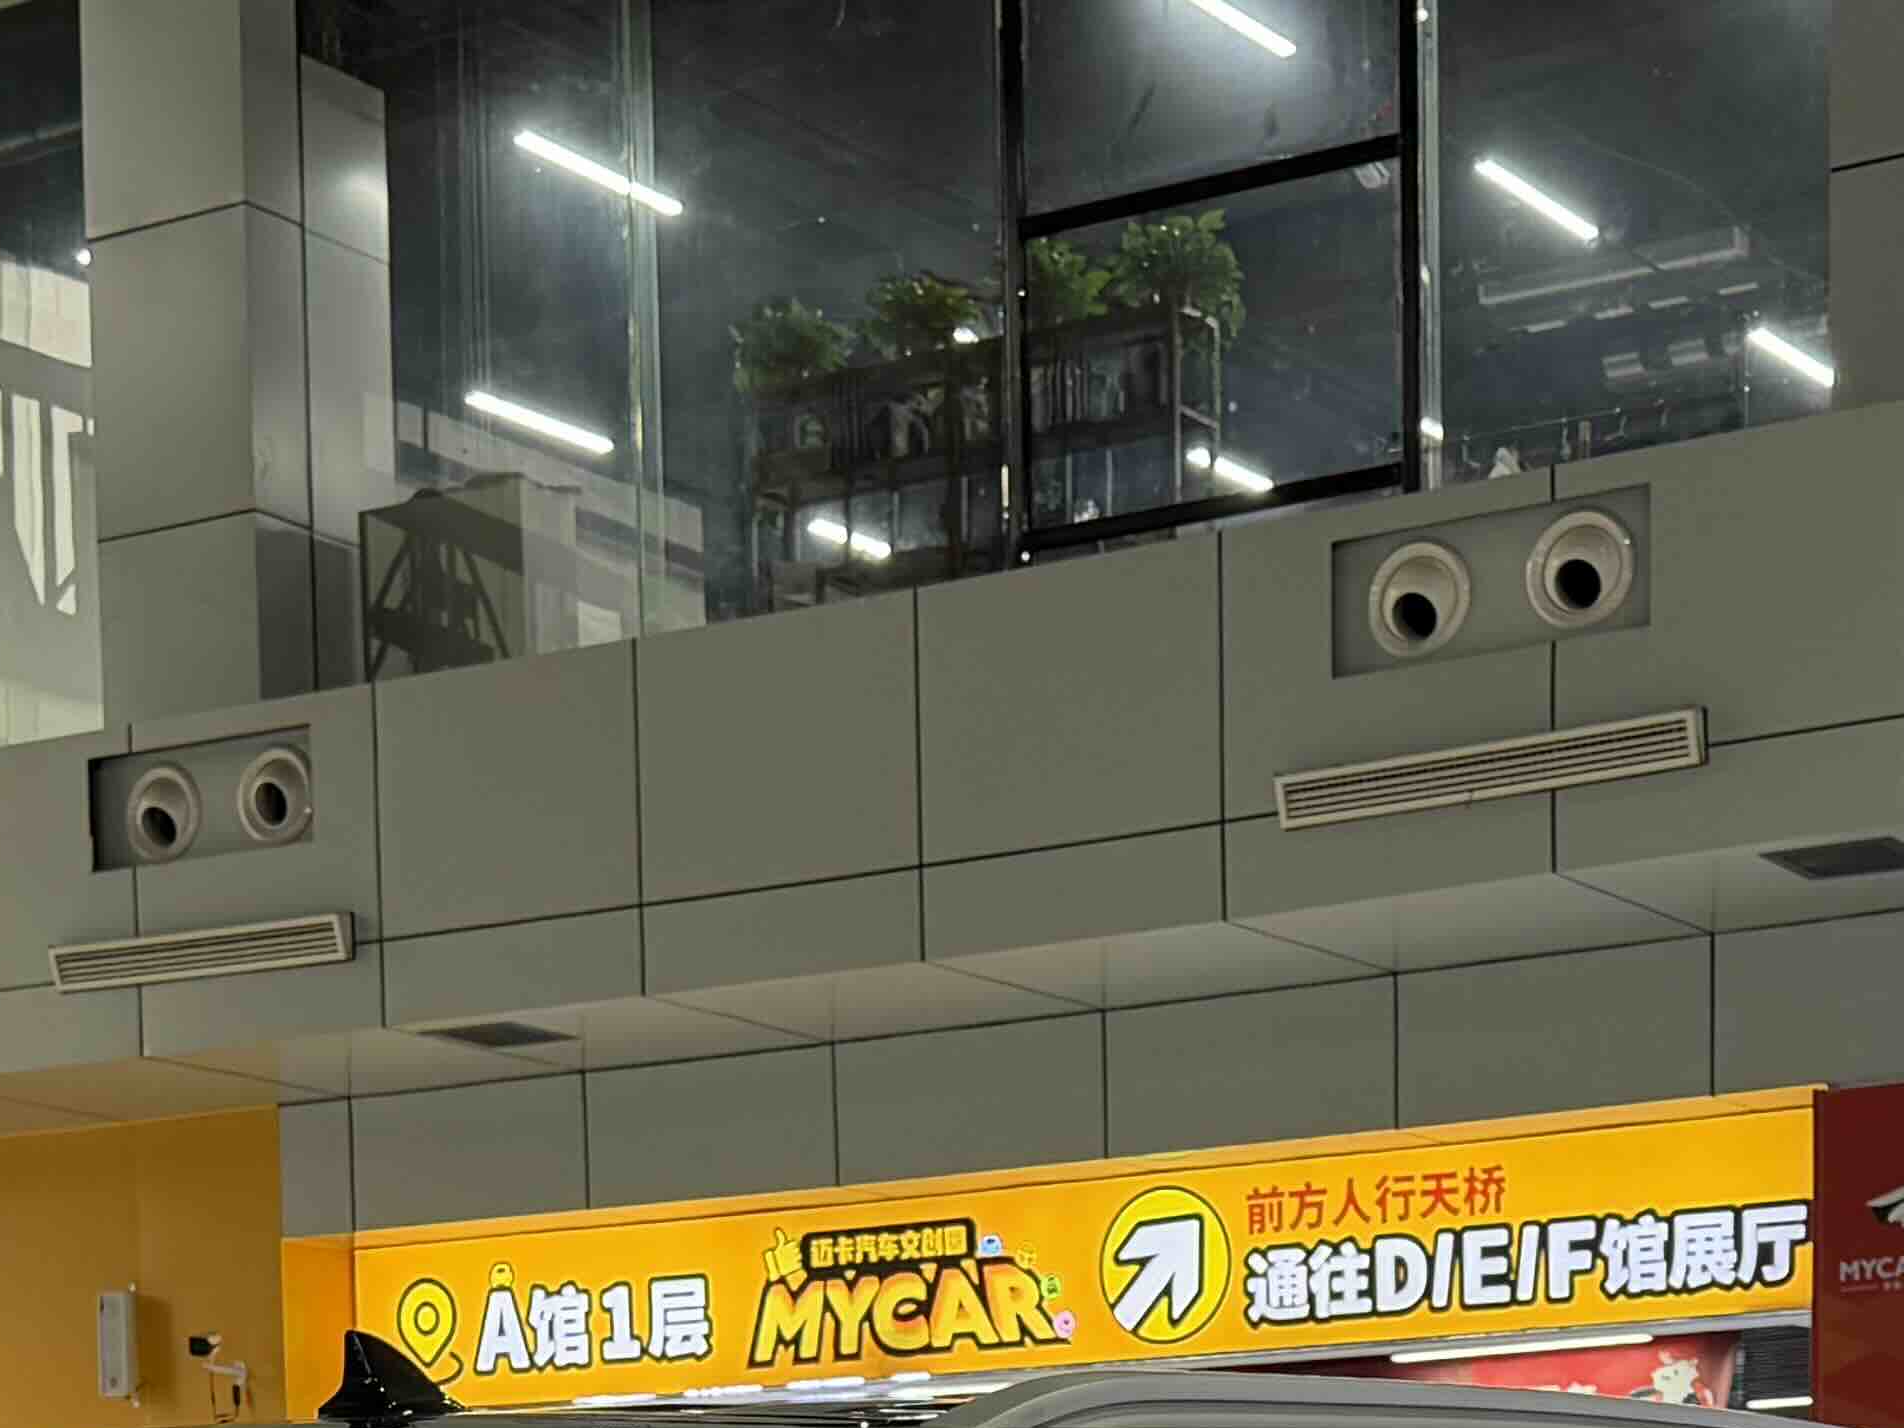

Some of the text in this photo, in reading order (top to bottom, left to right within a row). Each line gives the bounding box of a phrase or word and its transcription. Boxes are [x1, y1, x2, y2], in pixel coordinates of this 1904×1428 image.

[809, 1224, 969, 1268] 迈卡汽车文创园
[1246, 1165, 1507, 1235] 前方人行天桥
[1246, 1203, 1809, 1324] 通往D/E/F馆展厅
[475, 1276, 711, 1373] A馆1层
[750, 1263, 1060, 1366] MYCAR
